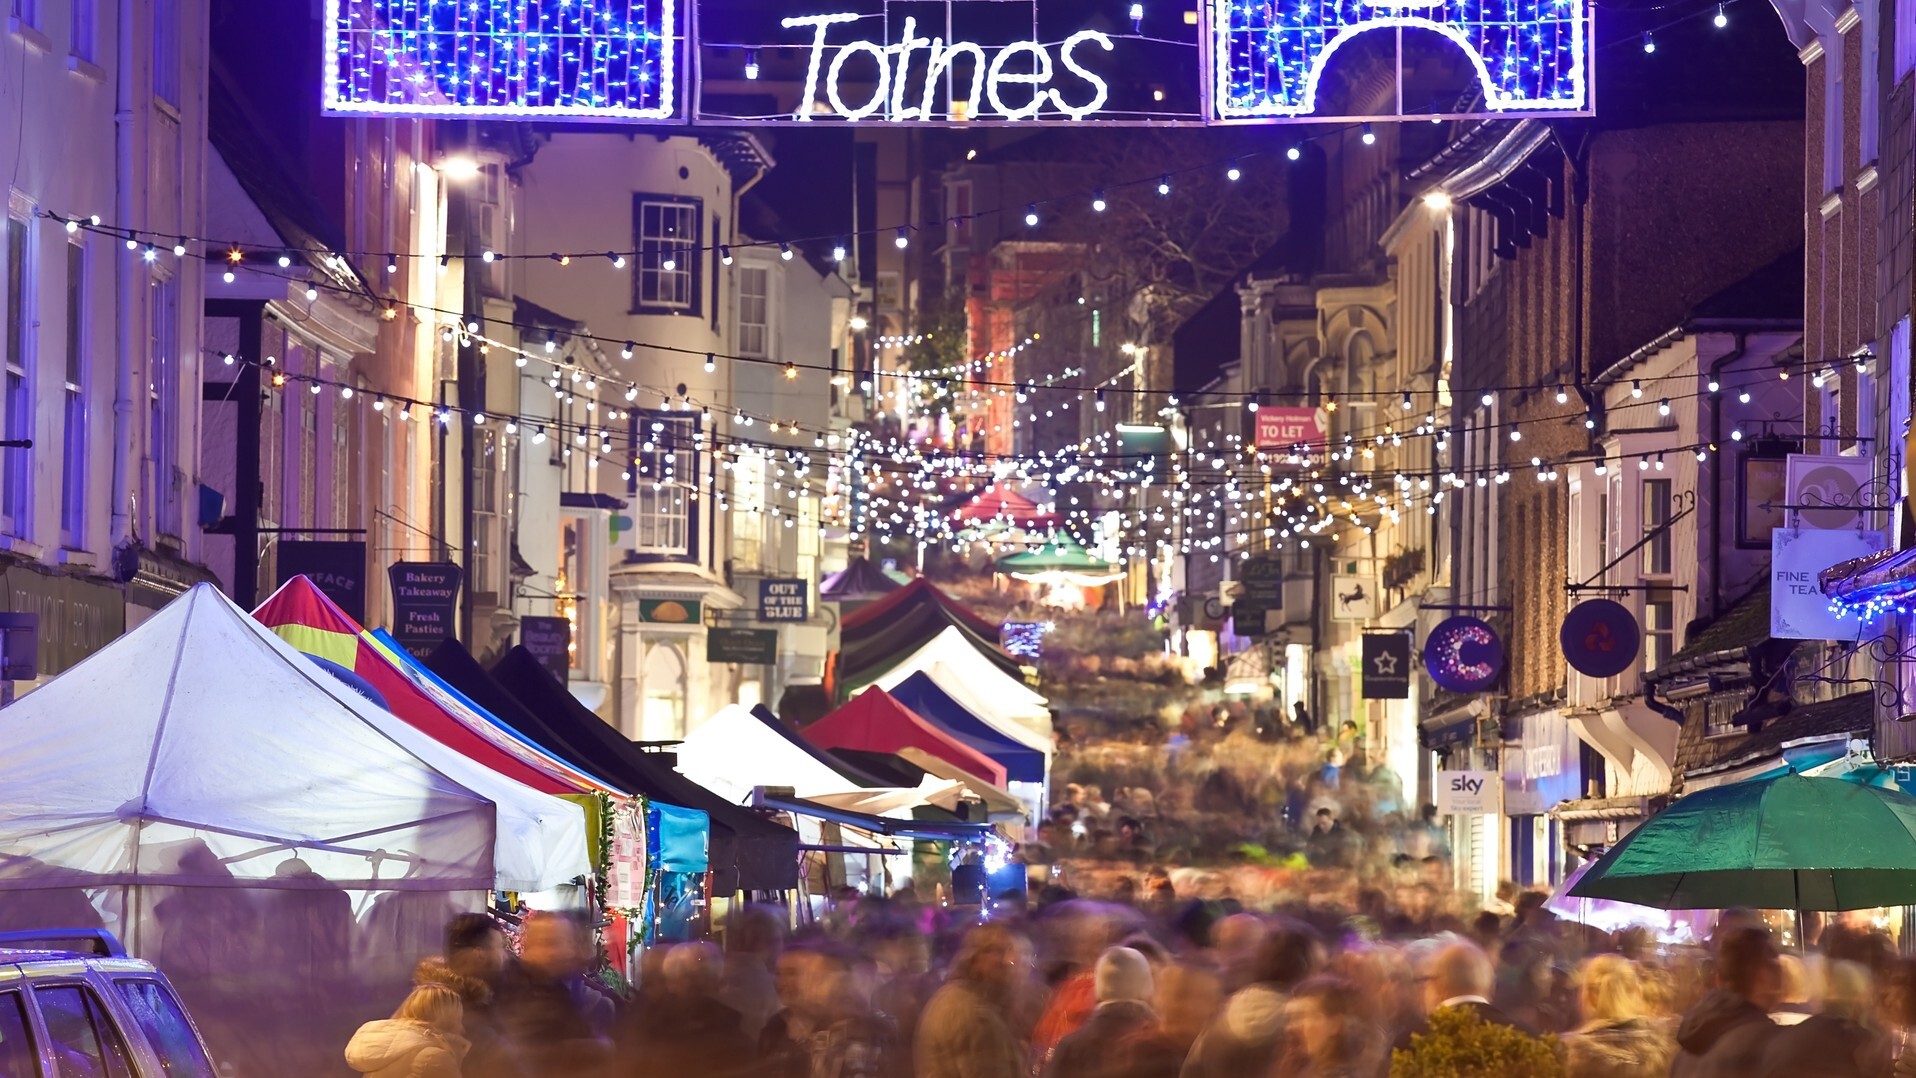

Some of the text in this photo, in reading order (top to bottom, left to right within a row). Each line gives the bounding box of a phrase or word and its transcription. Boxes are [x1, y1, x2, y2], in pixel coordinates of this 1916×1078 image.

[781, 13, 1114, 121] Totnes
[1261, 425, 1304, 438] TO LET
[406, 572, 445, 584] Bakery
[1777, 571, 1809, 582] FINE
[399, 586, 452, 598] Takeaway
[769, 583, 799, 595] OUT
[1789, 584, 1818, 595] TEA
[764, 596, 803, 605] OF THE
[409, 611, 440, 622] Fresh
[764, 606, 802, 618] BLUE
[405, 624, 444, 634] Pasties
[407, 647, 432, 656] Coff
[1451, 774, 1484, 796] sky
